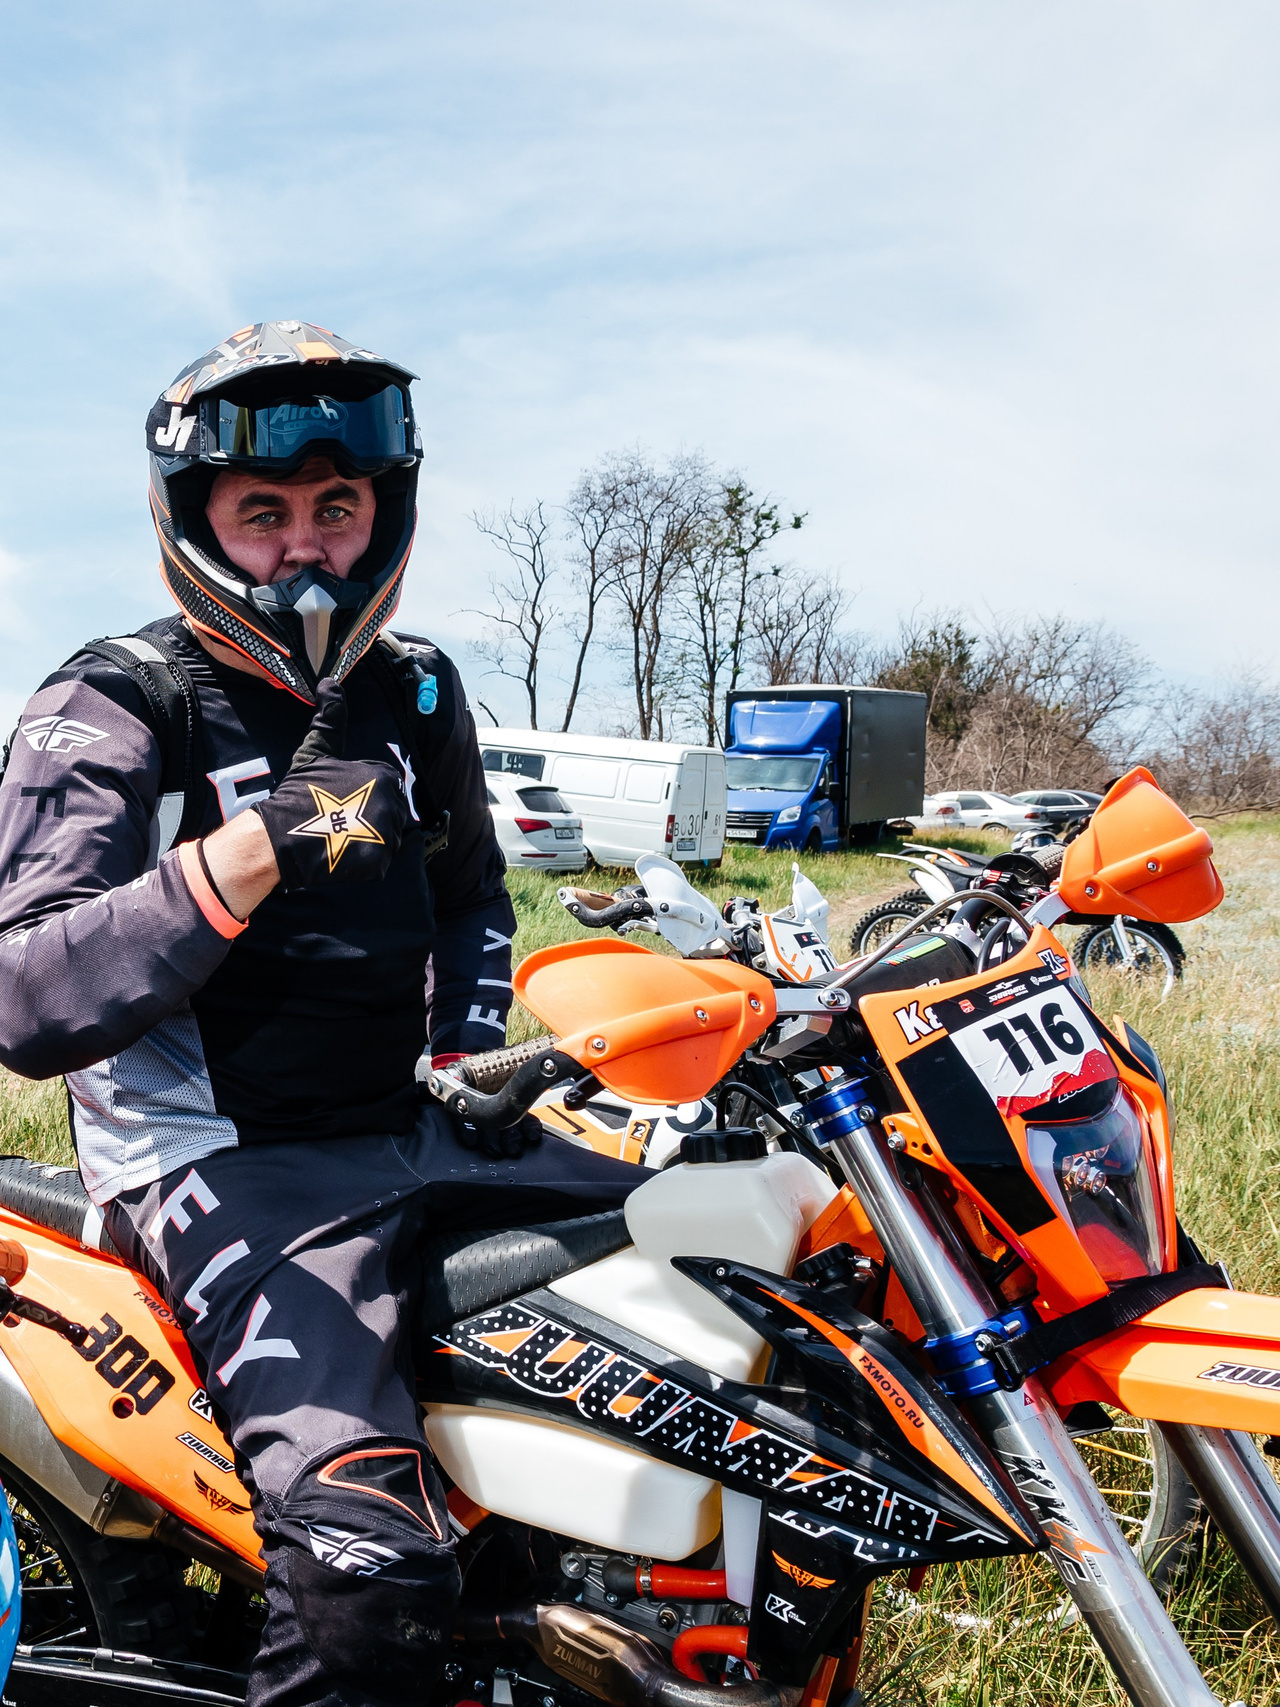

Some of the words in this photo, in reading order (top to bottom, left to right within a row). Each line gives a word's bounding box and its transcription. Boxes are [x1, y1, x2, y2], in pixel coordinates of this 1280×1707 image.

[272, 652, 297, 687] Airoh
[982, 1002, 1085, 1077] 116
[148, 1167, 301, 1387] FLY
[69, 1312, 176, 1416] 300
[858, 1354, 925, 1430] FXMOTO.RU
[180, 1432, 236, 1471] ZUUMAV
